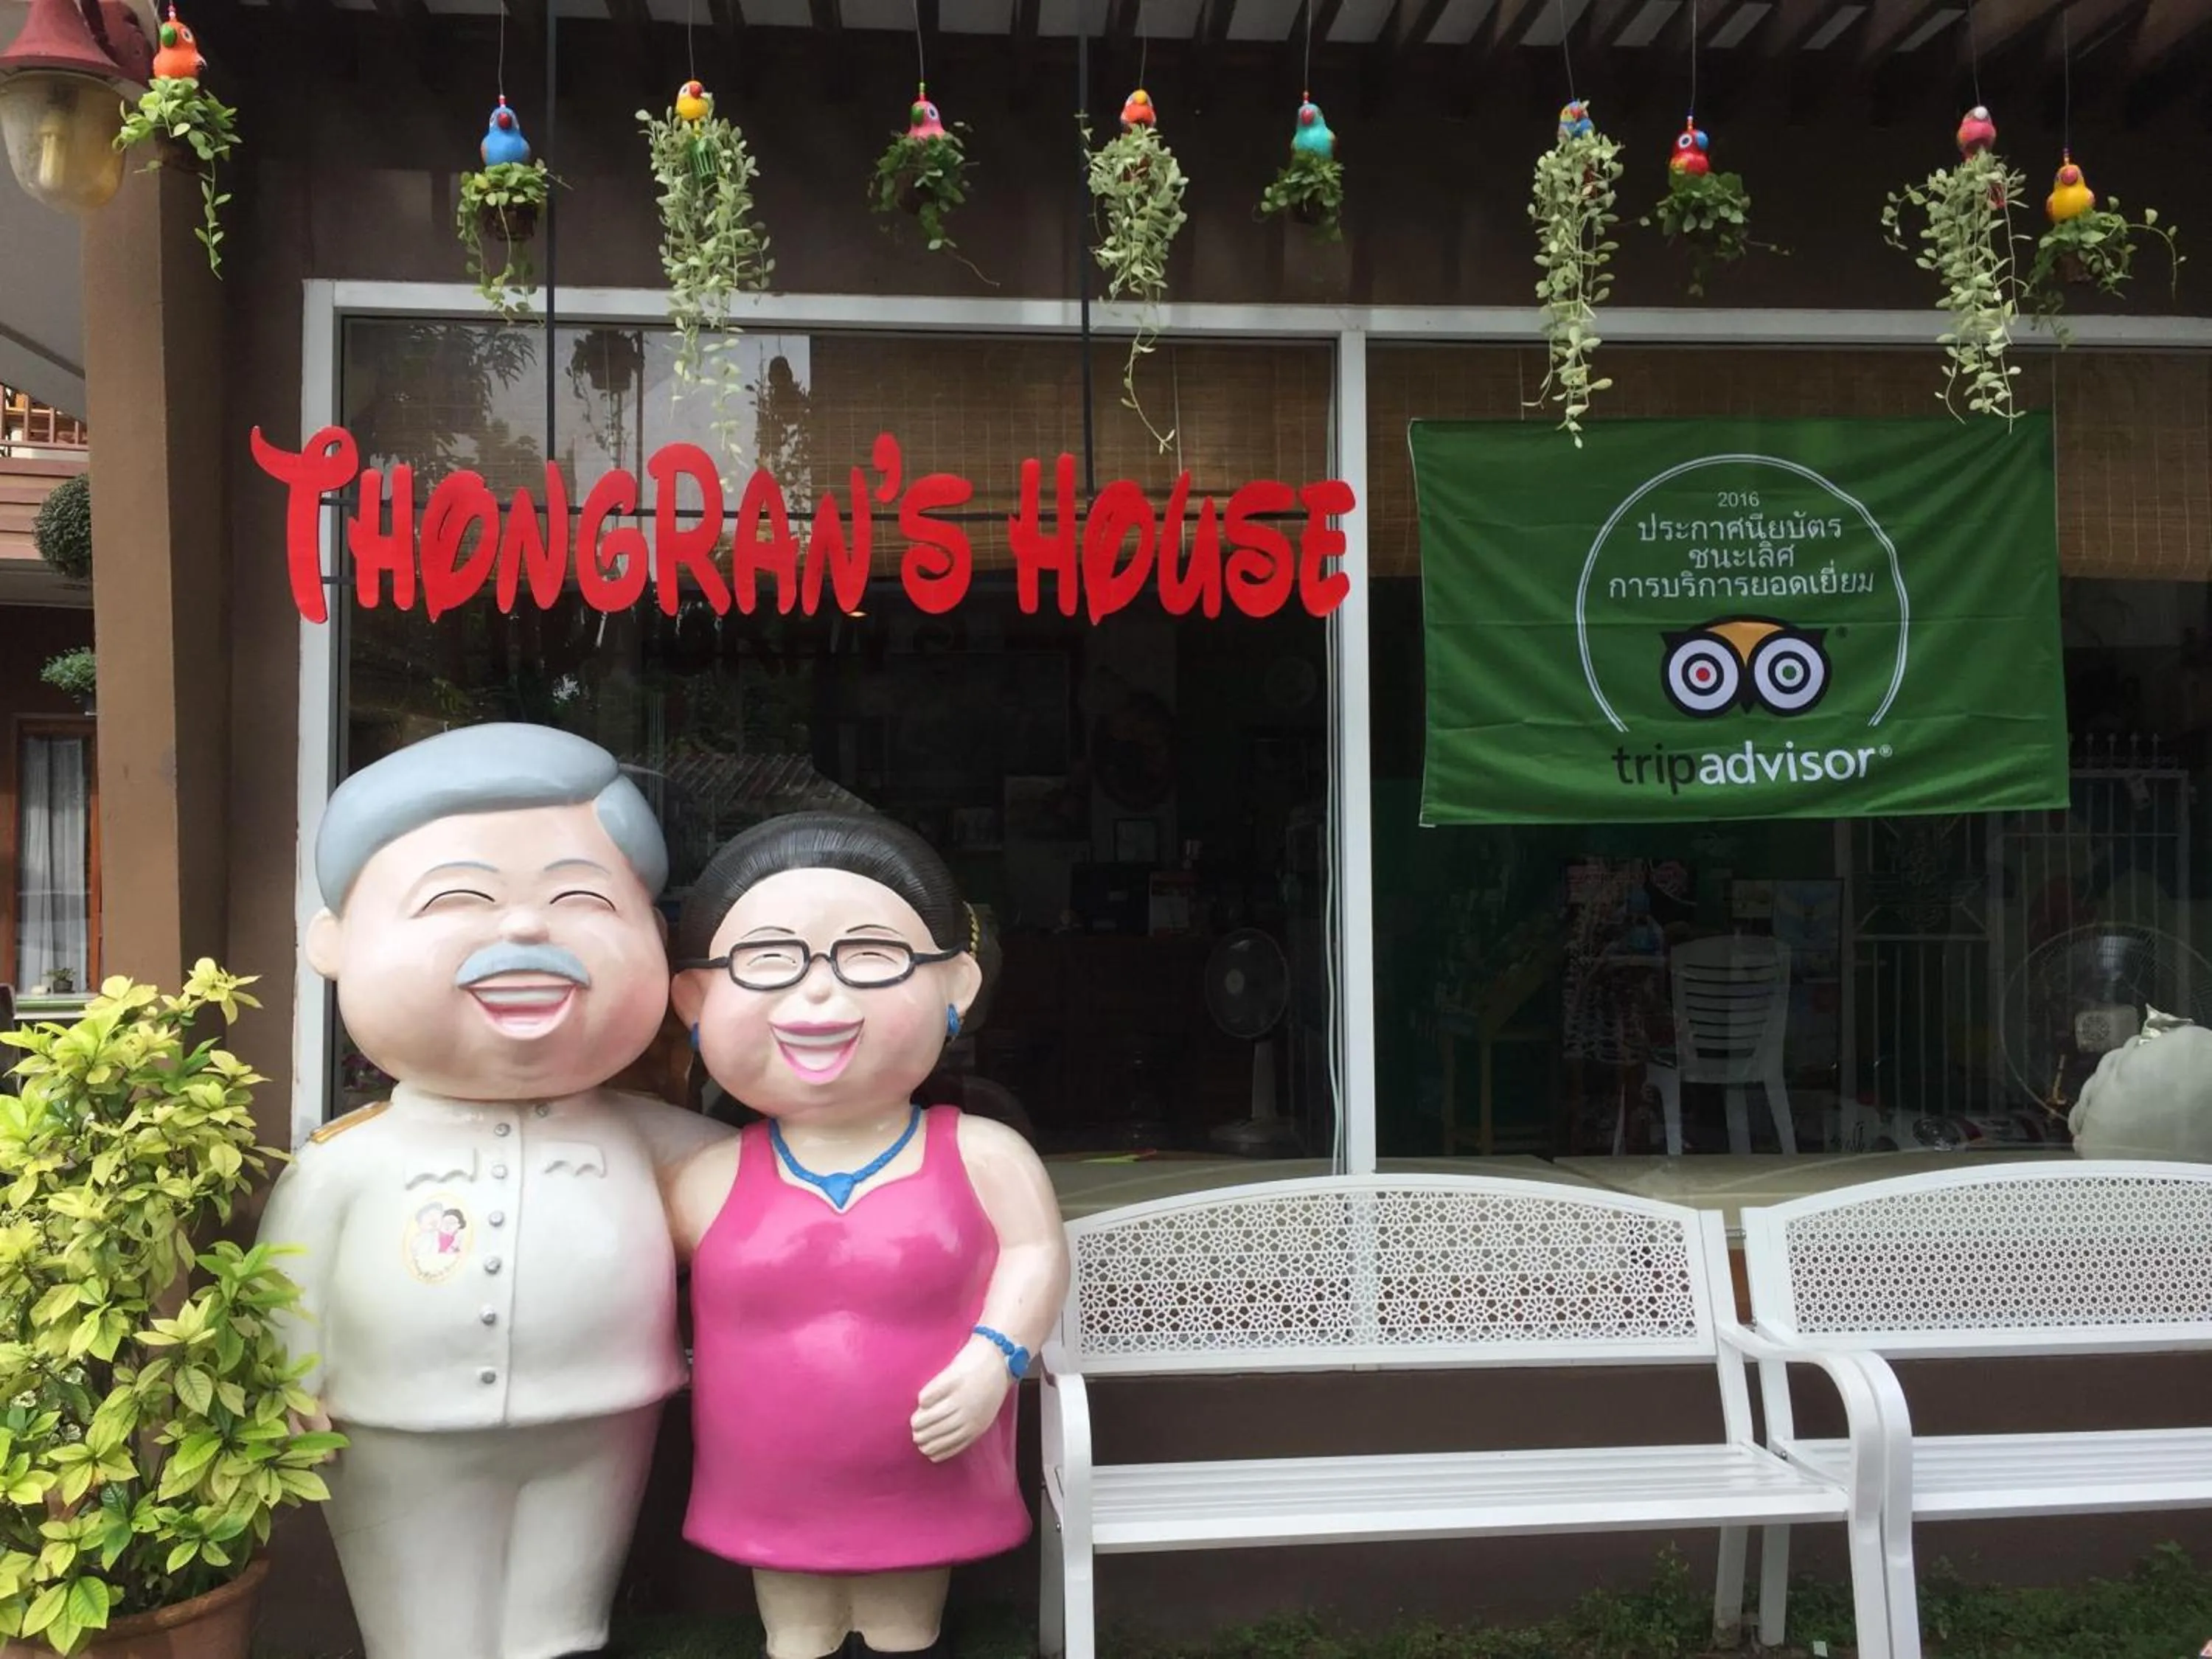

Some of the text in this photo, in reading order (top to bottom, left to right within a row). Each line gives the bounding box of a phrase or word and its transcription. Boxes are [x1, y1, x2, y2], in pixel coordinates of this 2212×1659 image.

[1717, 492, 1760, 507] 2016
[1008, 451, 1356, 625] HOUSE
[1638, 510, 1842, 541] ประกาศนียบัตร
[1688, 541, 1795, 569] ชนะเลิศ
[1610, 560, 1874, 598] การบริการยอดเยี่ยม
